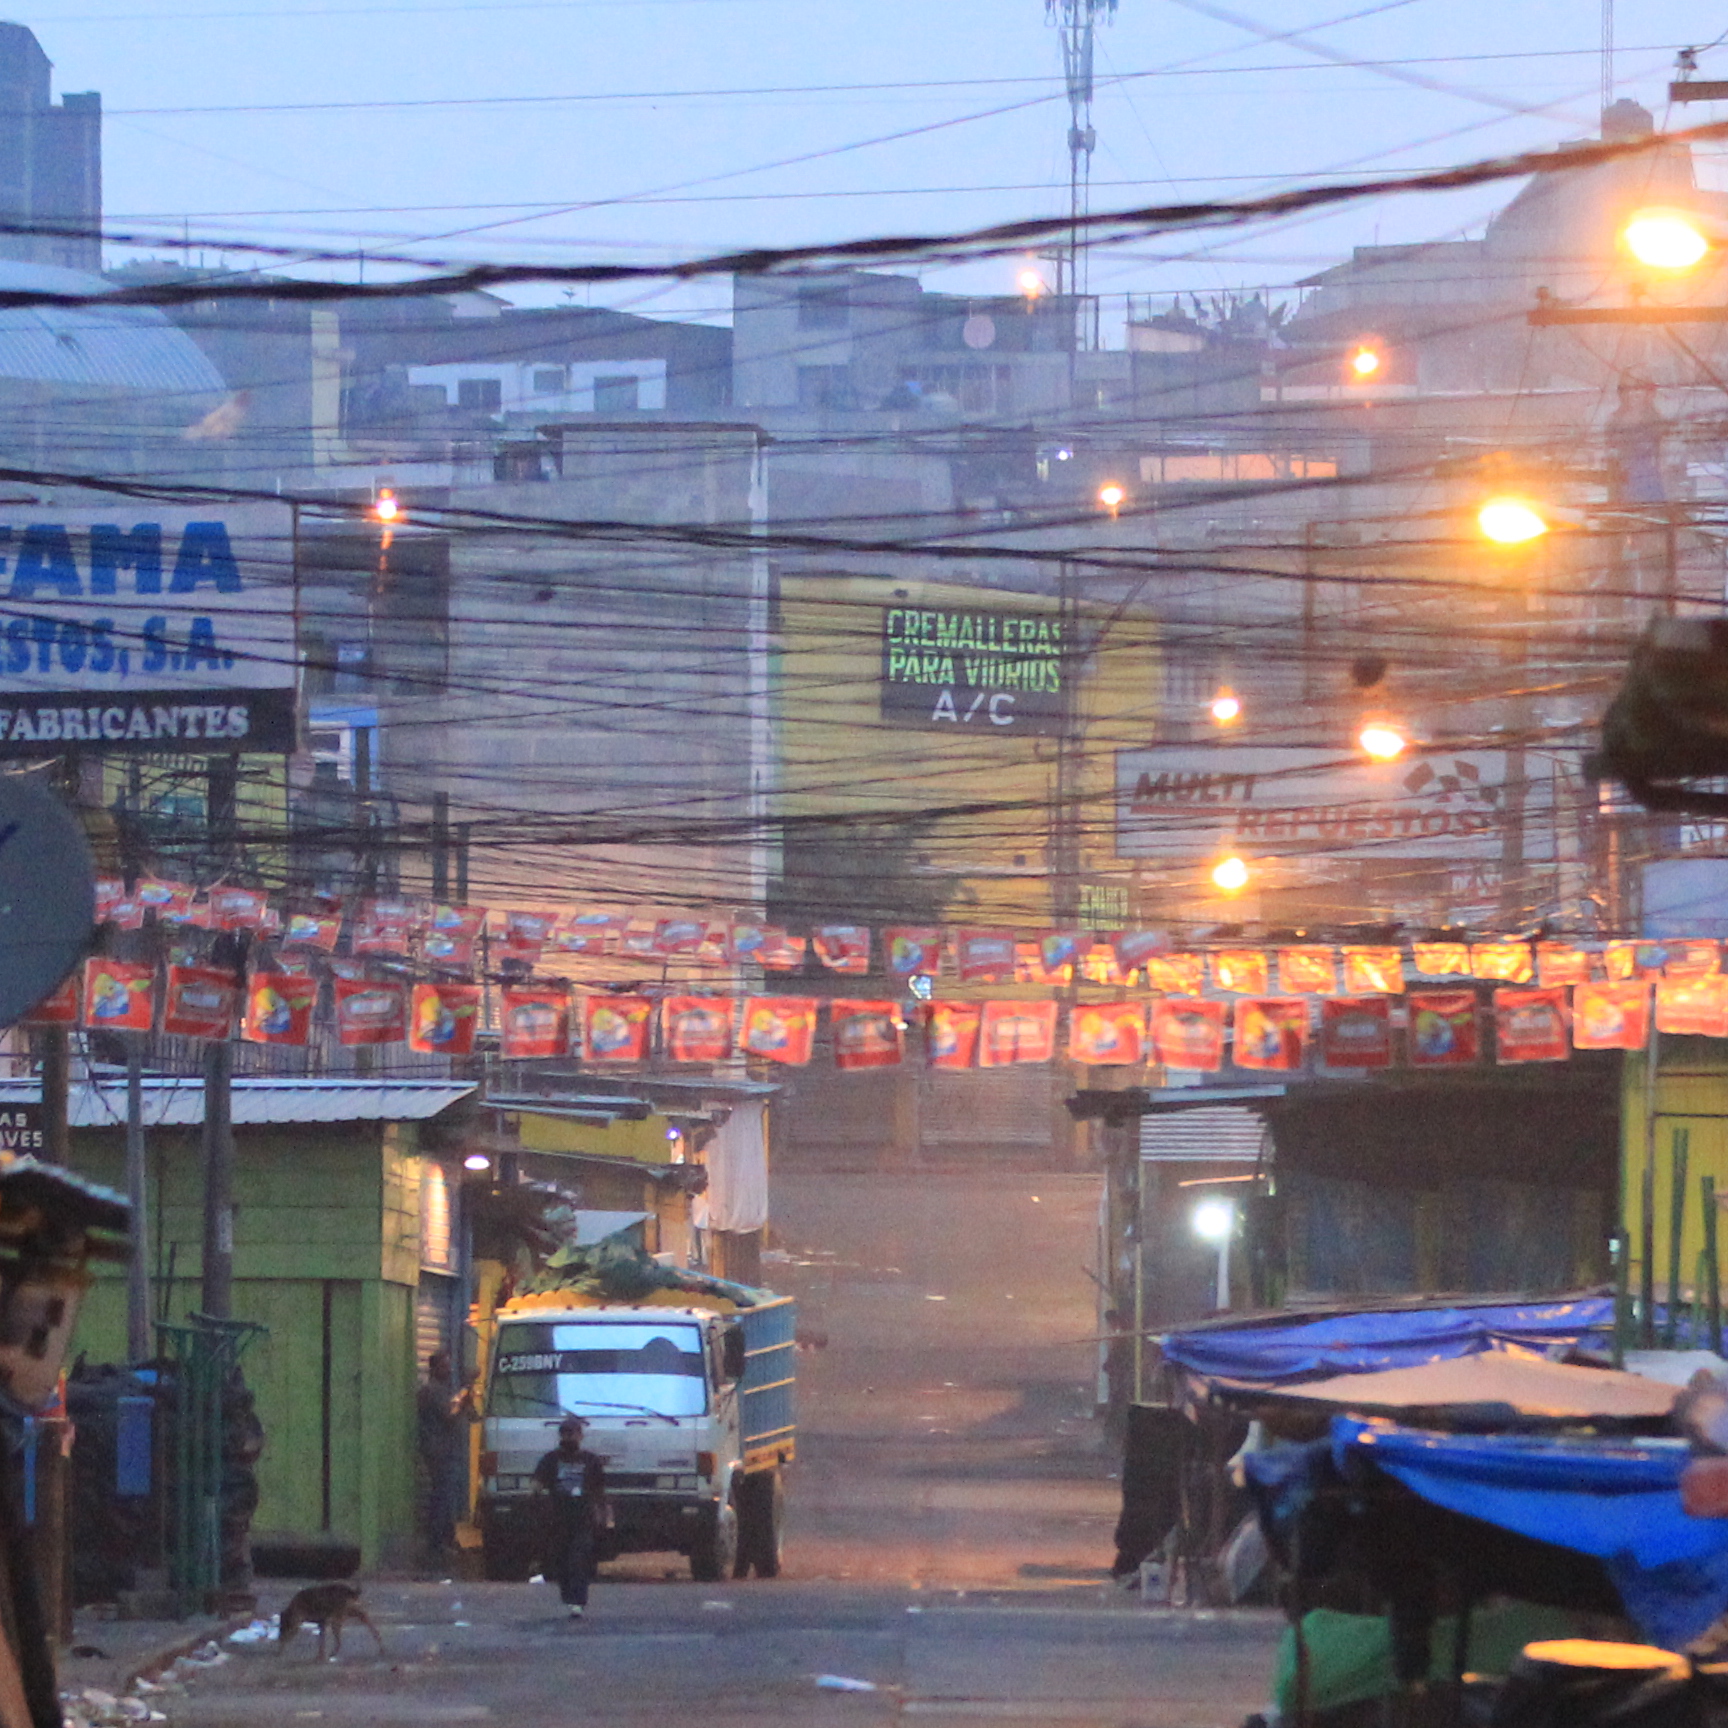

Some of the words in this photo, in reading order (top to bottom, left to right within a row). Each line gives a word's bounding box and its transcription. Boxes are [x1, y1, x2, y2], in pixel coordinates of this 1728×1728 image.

[888, 647, 956, 685] PARA
[931, 689, 1016, 726] A/C
[1132, 772, 1257, 801] MULTI
